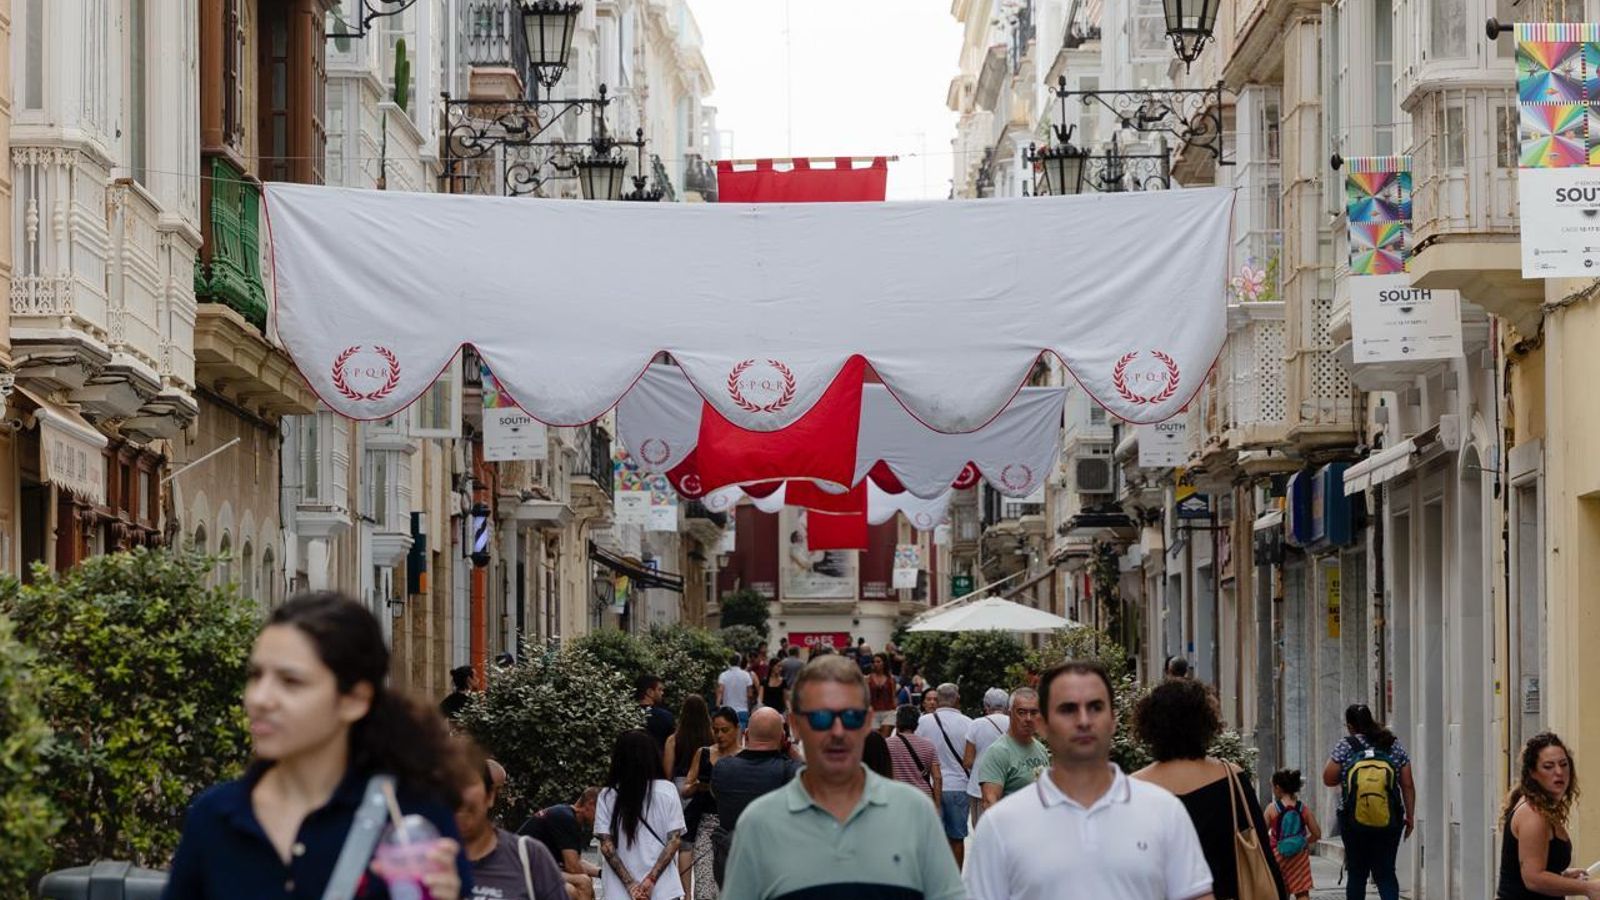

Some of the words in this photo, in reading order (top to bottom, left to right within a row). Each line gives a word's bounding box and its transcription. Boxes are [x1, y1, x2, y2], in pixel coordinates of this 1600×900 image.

[1379, 289, 1431, 302] SOUTH
[499, 416, 531, 425] SOUTH
[1154, 423, 1186, 431] SOUTH
[804, 635, 834, 646] GAES
